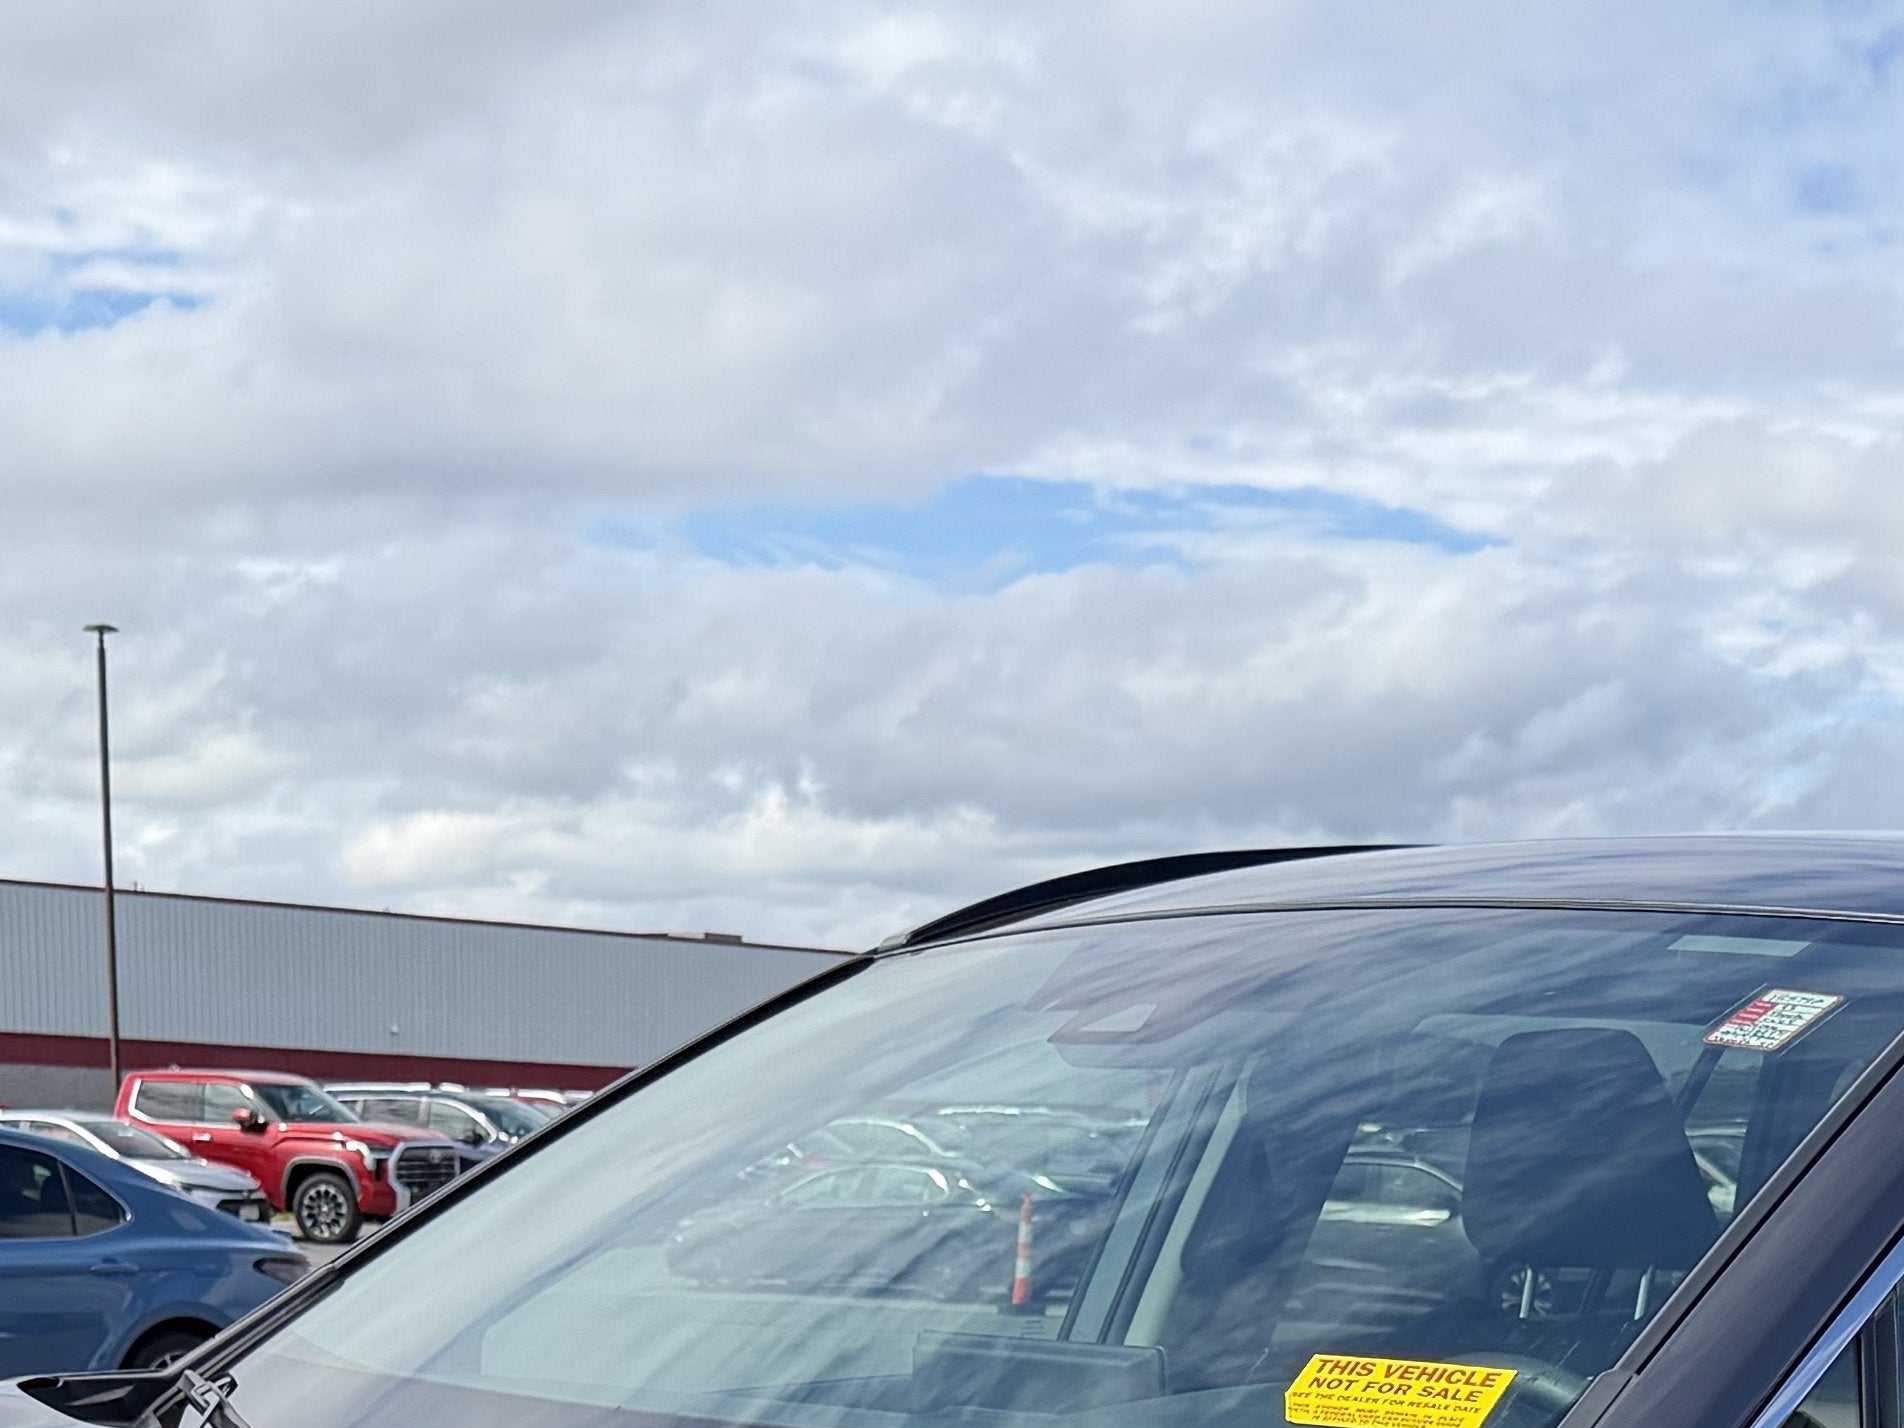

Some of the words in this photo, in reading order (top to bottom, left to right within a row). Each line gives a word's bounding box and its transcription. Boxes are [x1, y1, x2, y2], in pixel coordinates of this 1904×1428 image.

[1315, 1359, 1377, 1376] THIS
[1384, 1363, 1502, 1388] VEHICLE
[1308, 1377, 1360, 1392] NOT
[1361, 1381, 1413, 1396] FOR
[1416, 1385, 1484, 1403] SALE
[1314, 1393, 1334, 1401] THE
[1336, 1395, 1379, 1405] DEALER
[1381, 1398, 1404, 1408] FOR
[1406, 1400, 1451, 1411] RESALE
[1452, 1405, 1482, 1414] DATE
